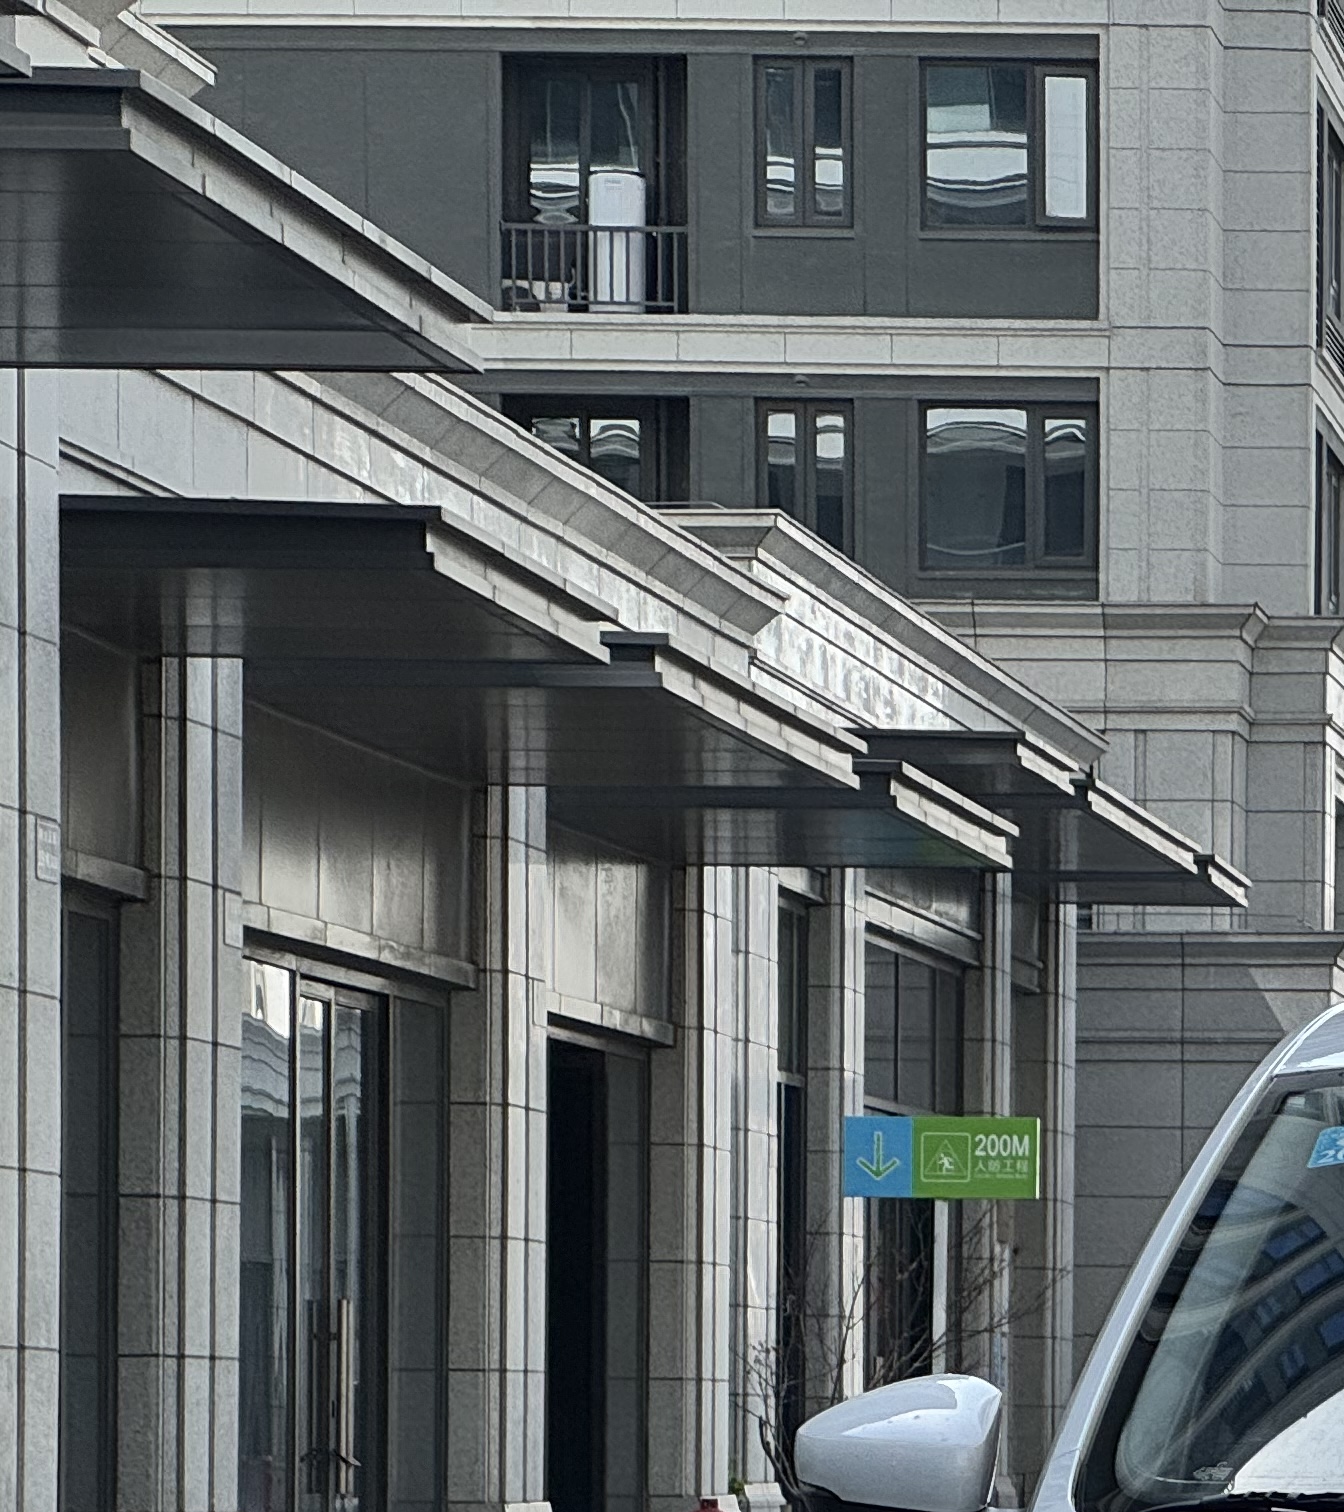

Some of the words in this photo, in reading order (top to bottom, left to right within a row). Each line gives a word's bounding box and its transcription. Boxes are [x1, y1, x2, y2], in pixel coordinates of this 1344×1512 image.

[974, 1133, 1029, 1157] 200M
[974, 1160, 1028, 1173] 人防工程
